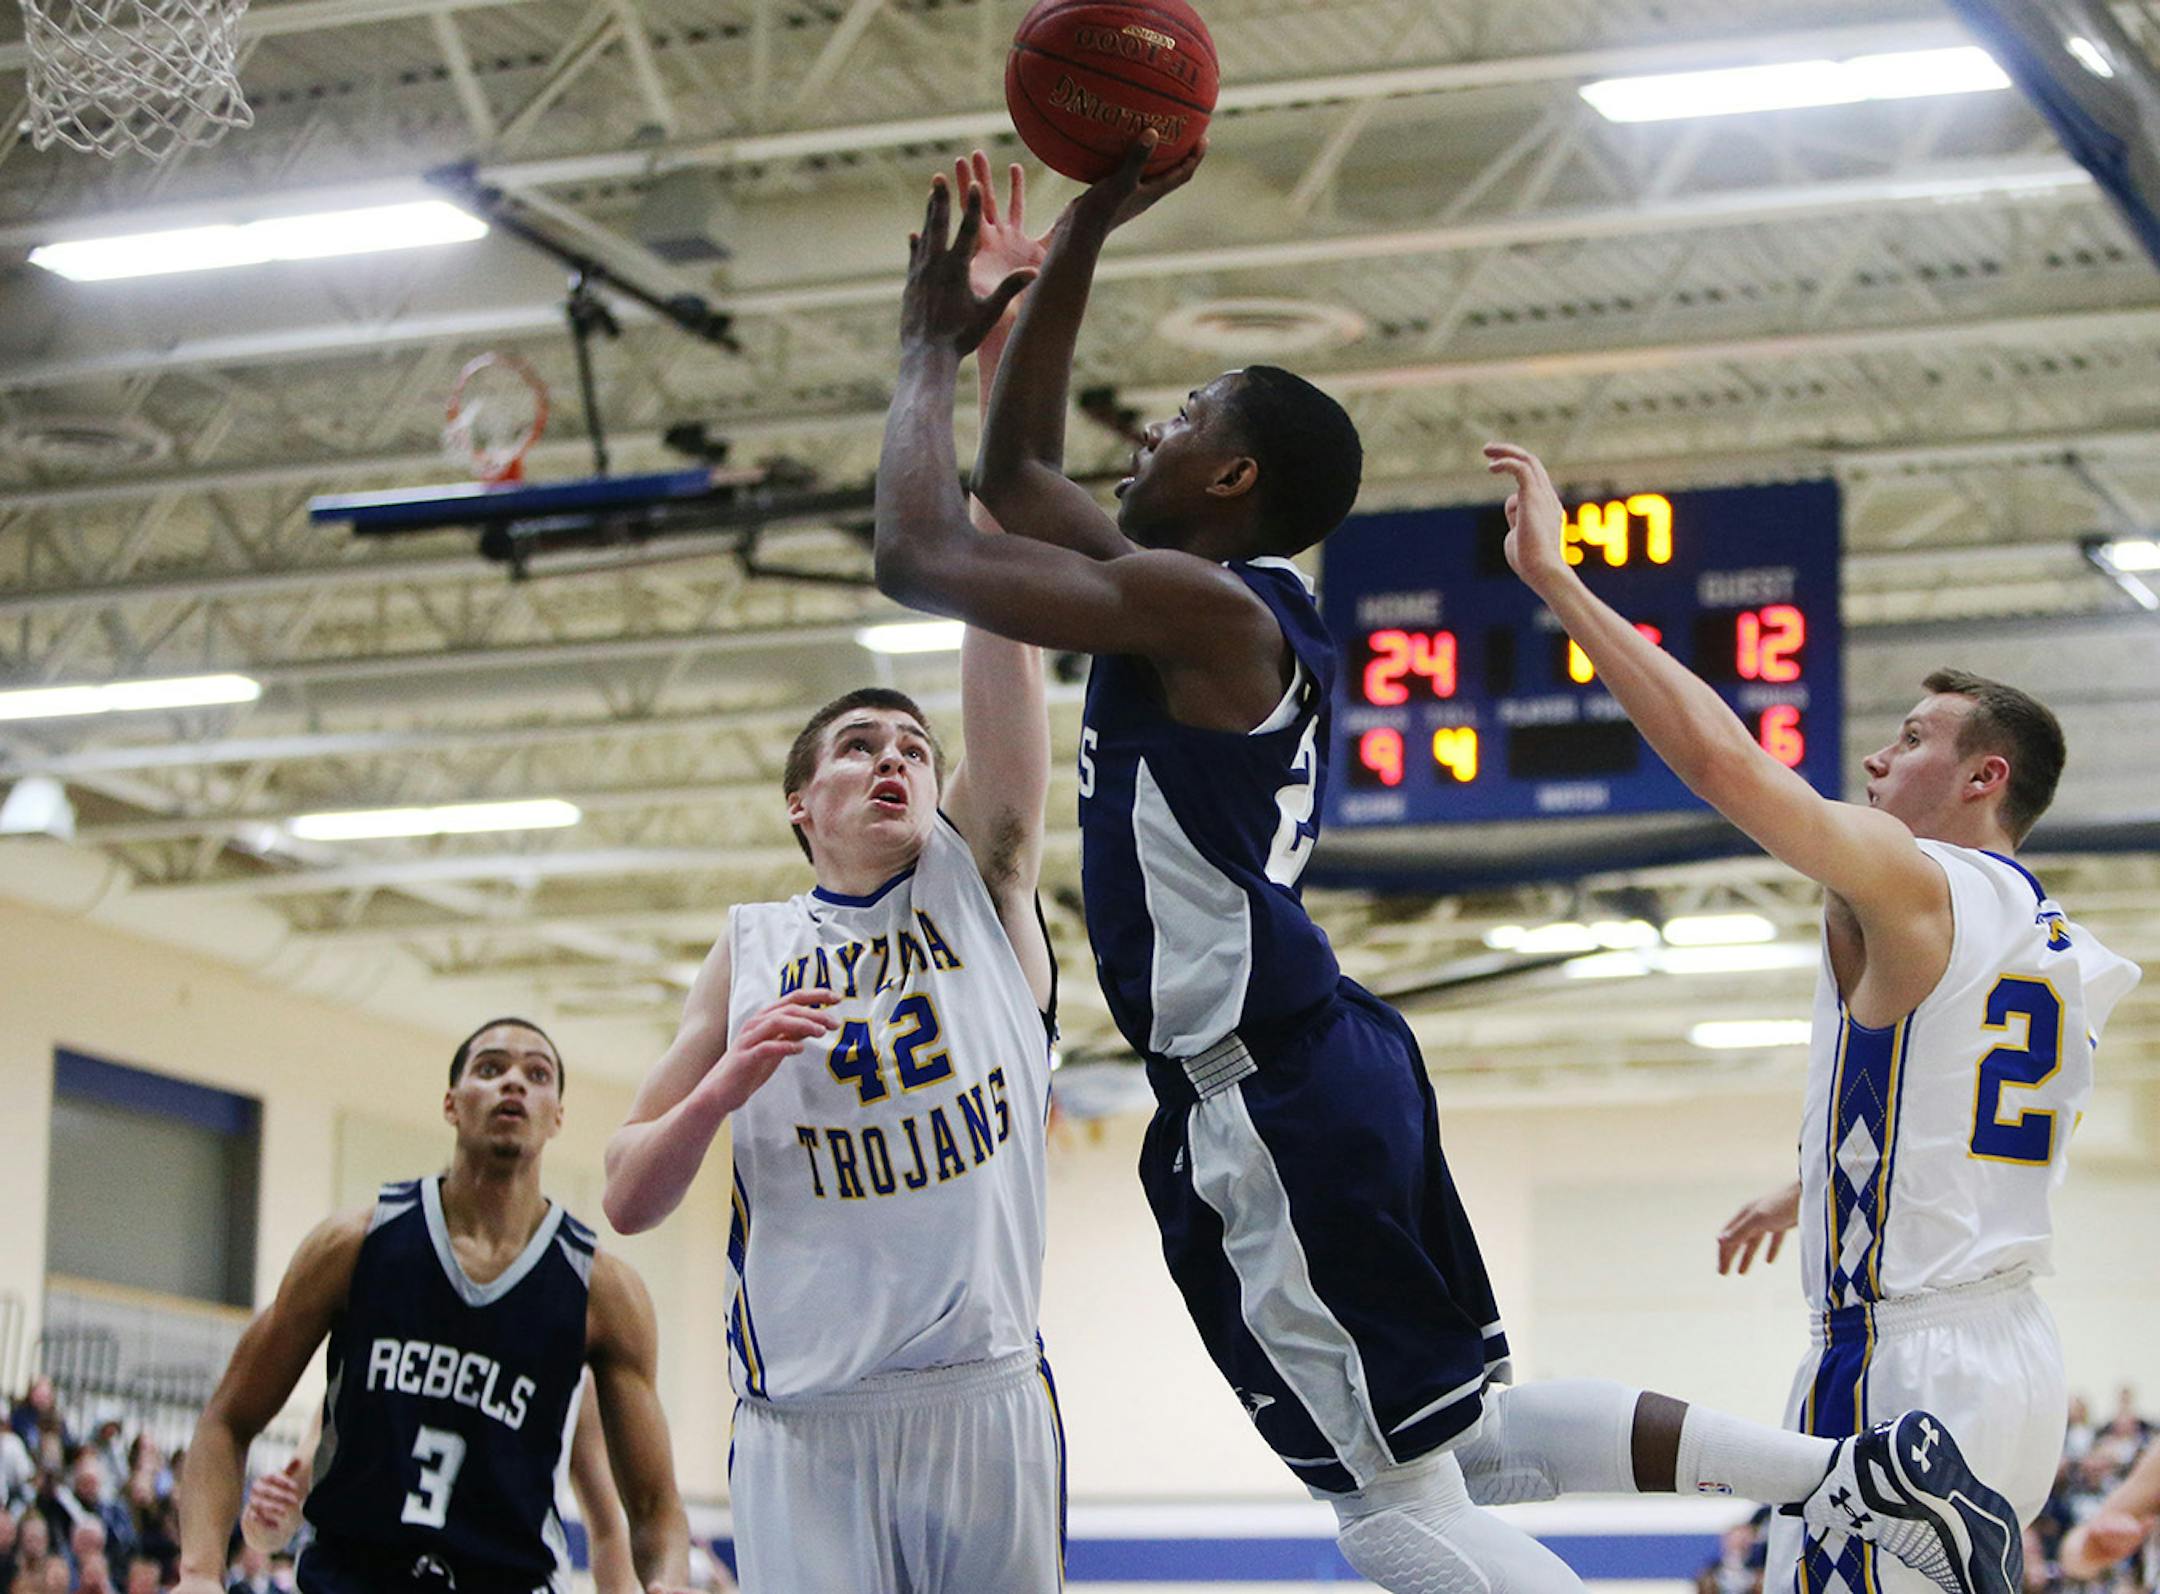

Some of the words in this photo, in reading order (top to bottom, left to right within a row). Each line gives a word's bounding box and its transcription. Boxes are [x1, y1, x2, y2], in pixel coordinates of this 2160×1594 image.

[1048, 73, 1188, 145] SPALDING
[1363, 629, 1457, 706] 24
[1736, 604, 1806, 682] 12
[1359, 727, 1404, 786] 9
[1432, 726, 1478, 783] 4
[1760, 704, 1806, 769] 6
[826, 992, 956, 1108] 42
[1967, 972, 2066, 1167] 2
[795, 1066, 1011, 1200] TROJANS
[366, 1338, 537, 1430] REBELS
[400, 1424, 468, 1530] 3
